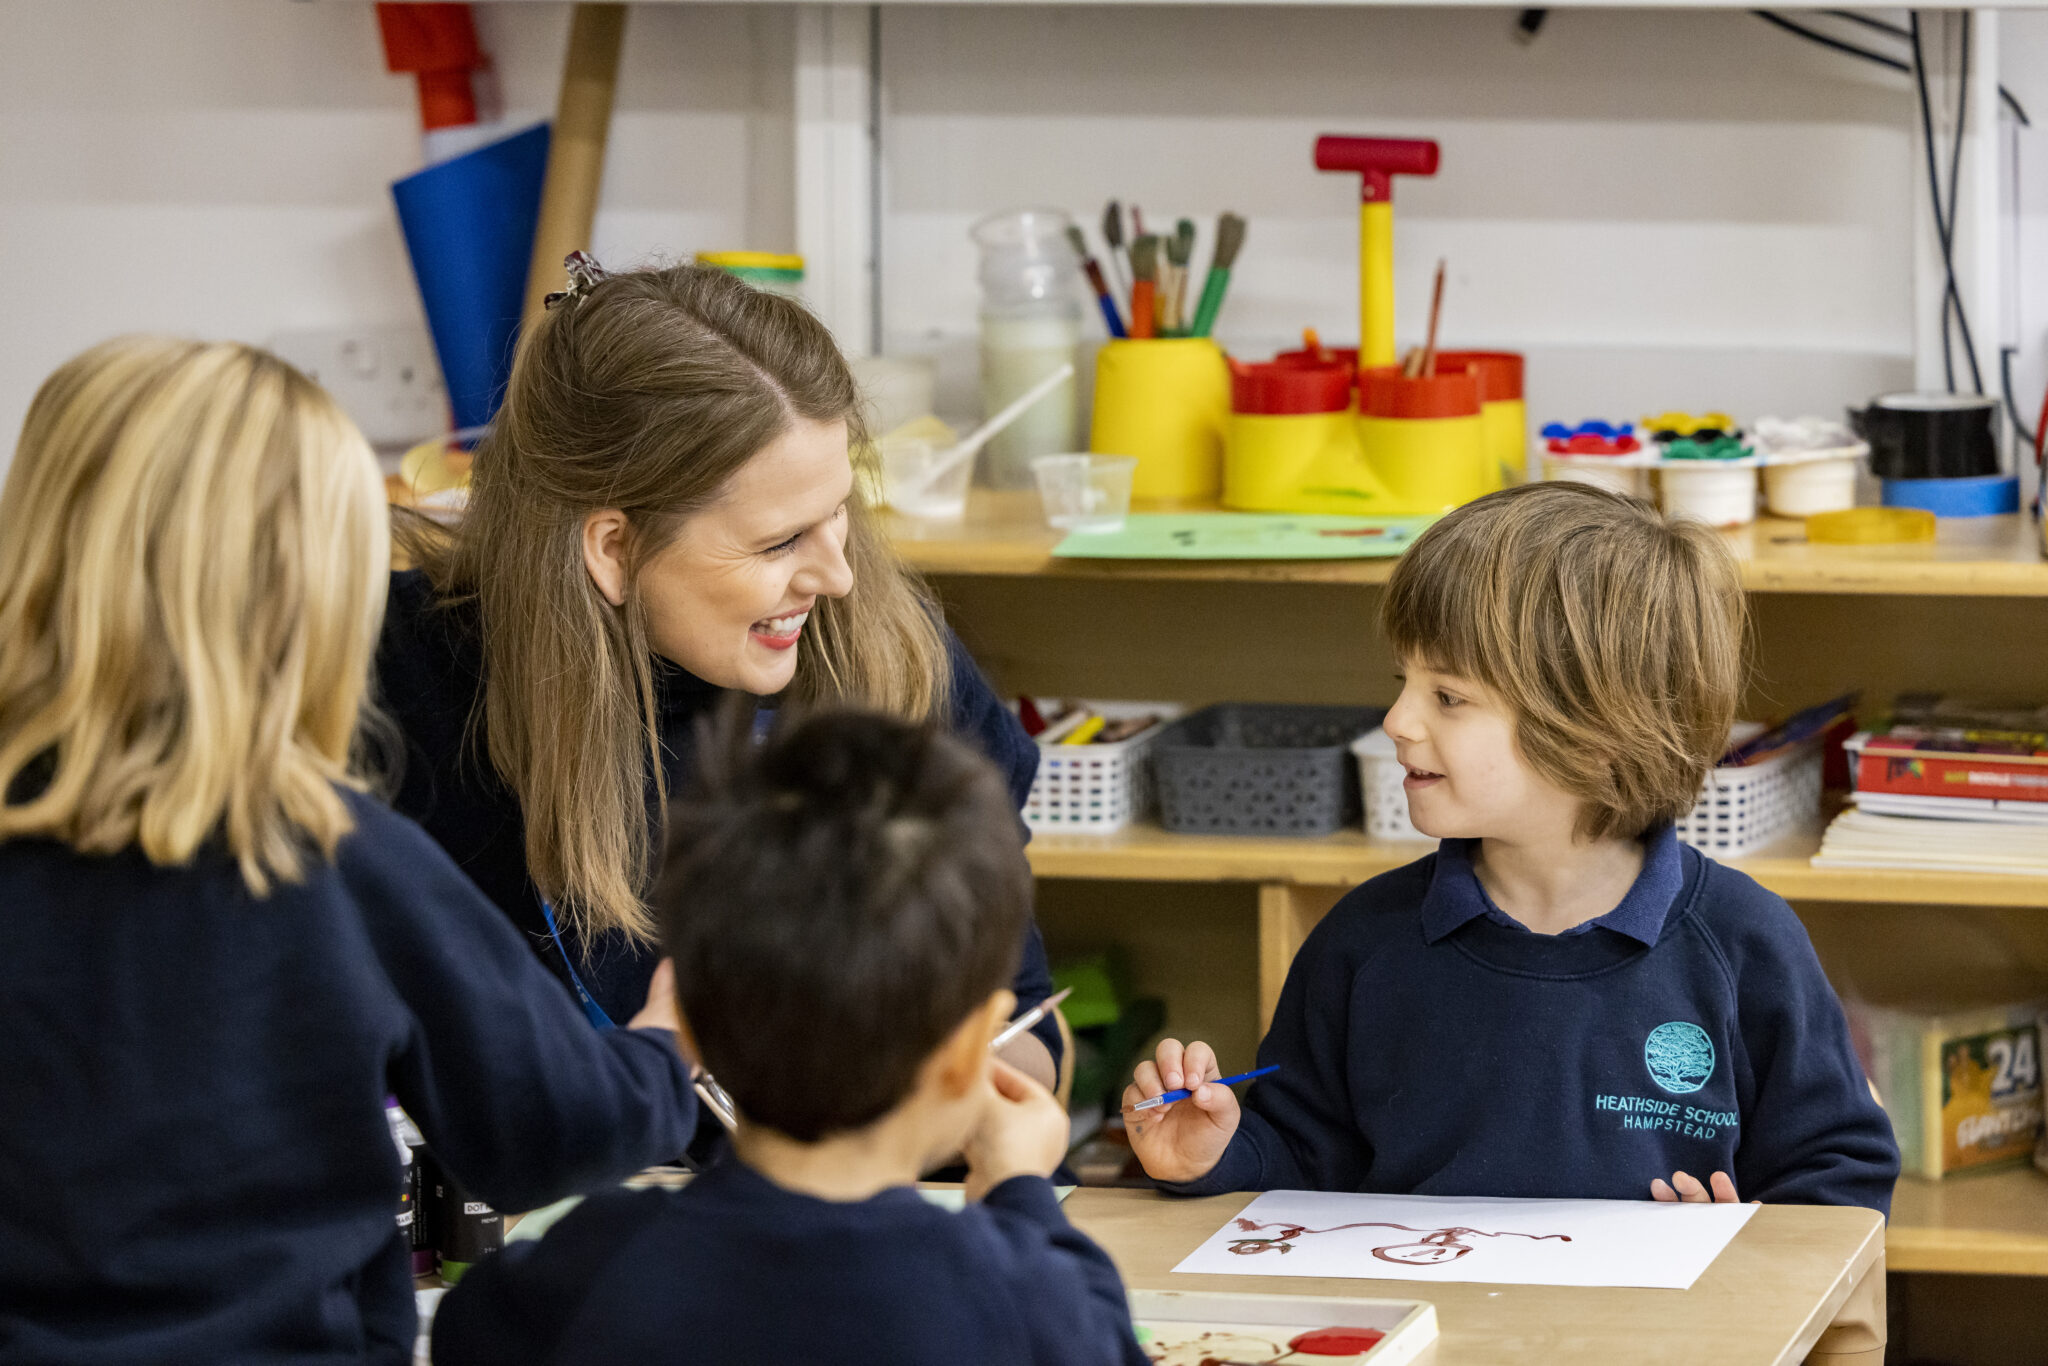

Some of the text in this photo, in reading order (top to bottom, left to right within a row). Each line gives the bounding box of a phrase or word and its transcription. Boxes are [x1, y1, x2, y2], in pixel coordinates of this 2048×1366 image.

[1988, 1036, 2036, 1091] 24
[1596, 1095, 1738, 1126] HEATHSIDE SCHOOL
[1624, 1115, 1716, 1139] HAMPSTEAD
